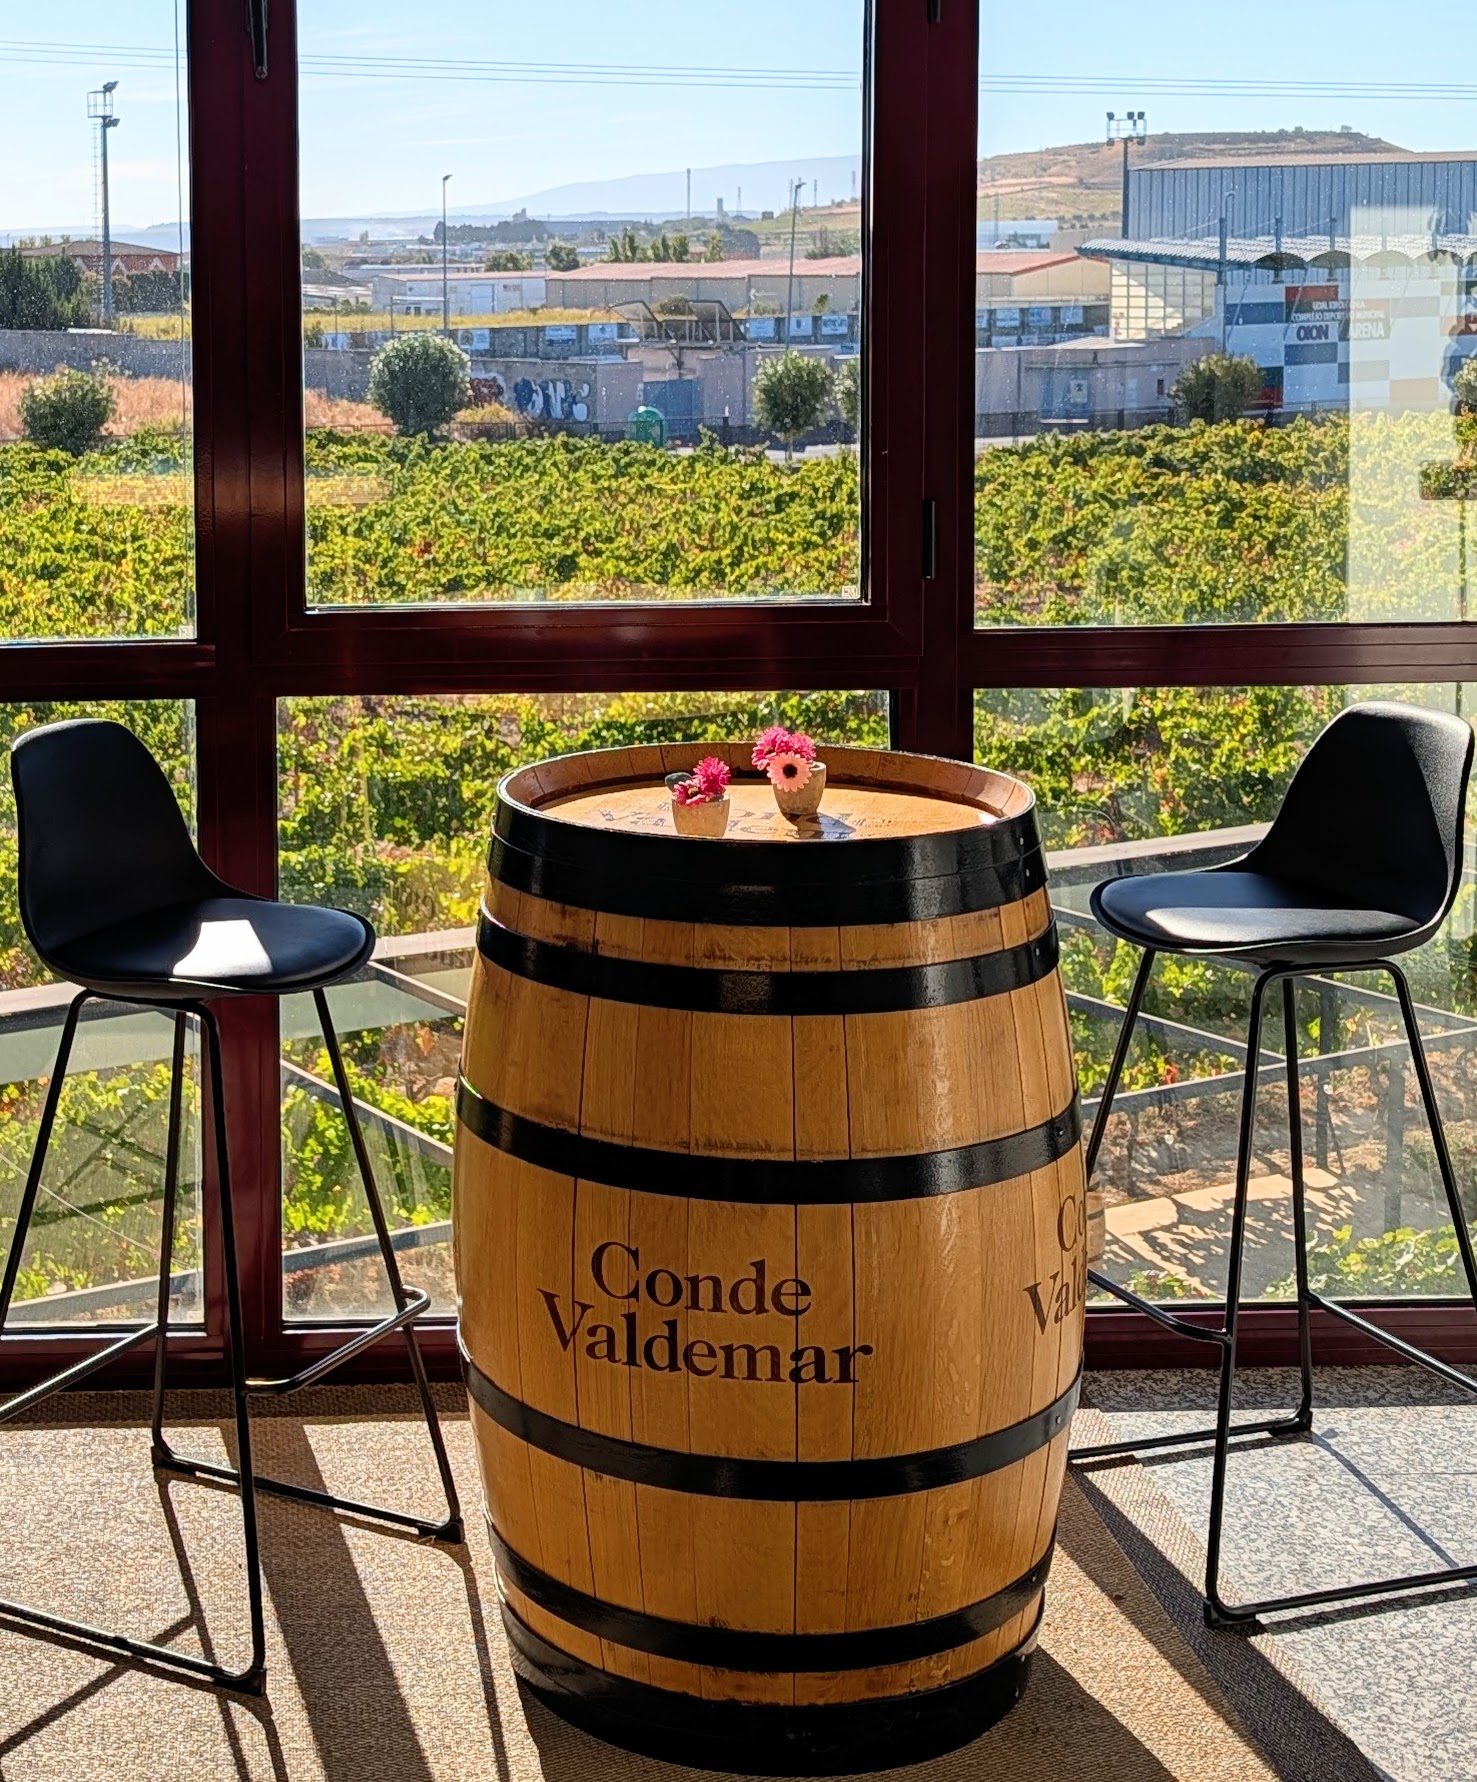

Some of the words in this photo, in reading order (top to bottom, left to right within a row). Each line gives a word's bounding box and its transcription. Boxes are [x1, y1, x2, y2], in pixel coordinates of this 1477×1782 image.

[1347, 321, 1385, 338] ARENA
[591, 1241, 811, 1317] Conde
[537, 1288, 873, 1385] Valdemar
